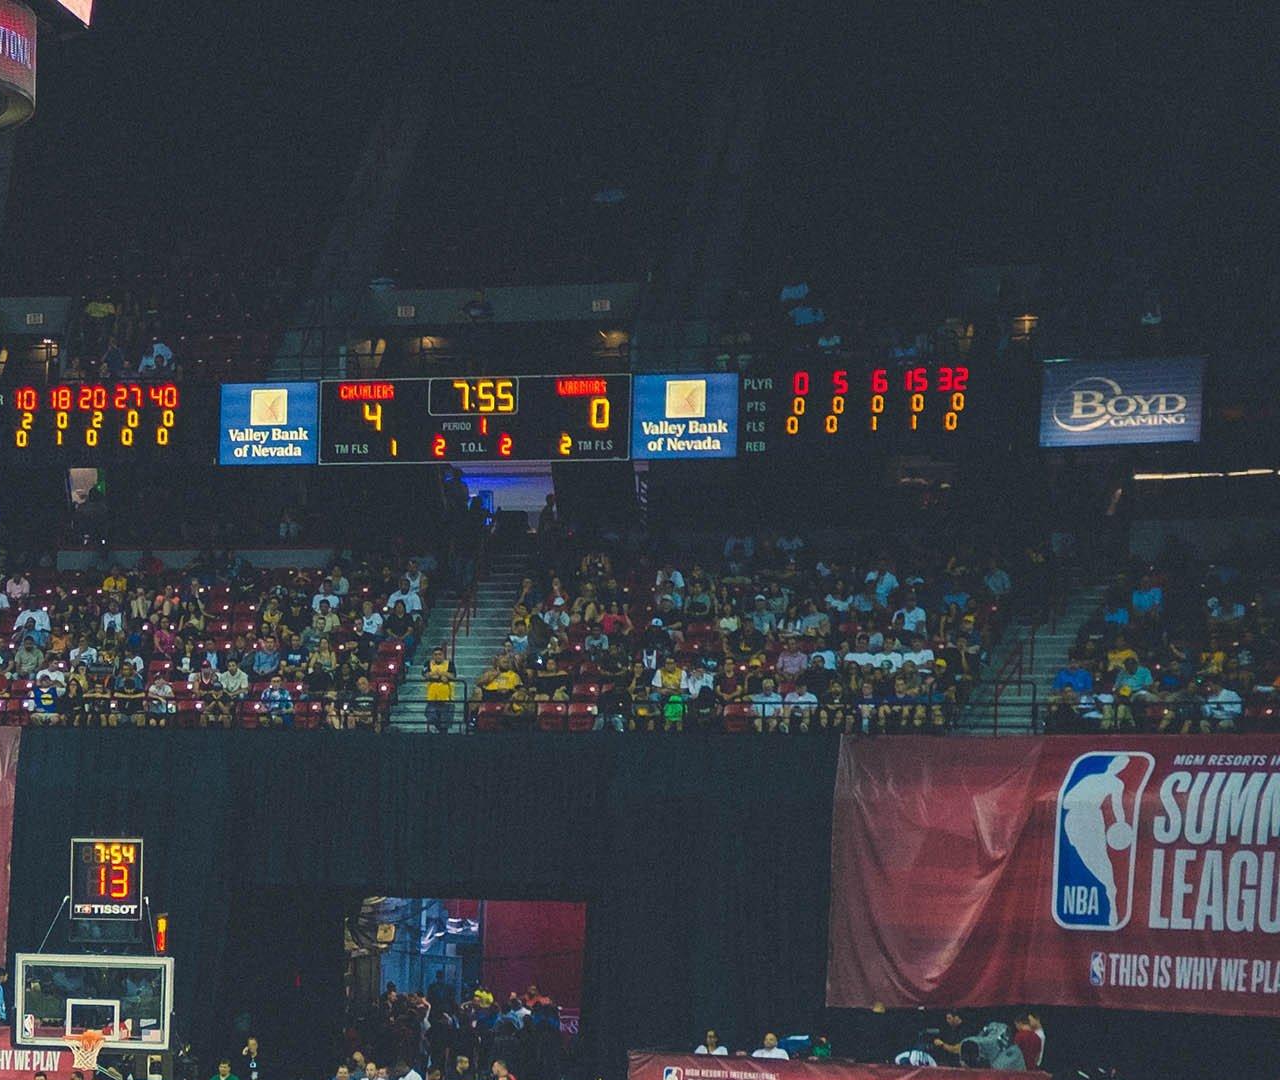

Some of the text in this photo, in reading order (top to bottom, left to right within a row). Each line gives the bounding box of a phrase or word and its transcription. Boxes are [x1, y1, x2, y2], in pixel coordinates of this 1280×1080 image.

[340, 384, 395, 399] CAVALIERS
[744, 367, 969, 395] PLYR 0 5 6 15 32
[15, 388, 37, 411] 10
[51, 388, 72, 410] 18
[79, 387, 107, 409] 20
[115, 386, 142, 409] 27
[151, 386, 178, 409] 40
[453, 381, 514, 411] 7:55
[747, 392, 965, 415] PTS 0 0 0 0 0
[1070, 390, 1187, 419] BOYD
[22, 412, 33, 430] 2
[56, 411, 68, 429] 0
[92, 411, 103, 428] 2
[127, 410, 139, 428] 0
[163, 409, 174, 427] 0
[363, 403, 382, 431] 4
[591, 397, 610, 429] 0
[746, 412, 957, 435] FLS 0 0 0
[1110, 414, 1185, 427] GAMING
[16, 430, 27, 447] 0
[86, 429, 97, 446] 0
[121, 428, 133, 446] 0
[157, 427, 168, 445] 0
[229, 427, 308, 443] Valley Bank
[642, 419, 728, 437] Valley Bank
[234, 444, 302, 457] of Nevada
[335, 438, 398, 456] TM FLS 1
[435, 437, 446, 456] 2
[500, 436, 512, 455] 2
[559, 435, 613, 455] 2 TM FLS
[648, 437, 721, 451] of Nevada
[746, 441, 766, 452] REB
[1174, 755, 1204, 766] MGM
[1208, 754, 1268, 766] RESORTS
[95, 843, 136, 864] 7:54
[99, 865, 128, 898] 13
[92, 904, 138, 914] TISSOT
[1063, 886, 1099, 916] NBA
[1109, 953, 1149, 988] THIS
[1153, 954, 1171, 988] IS
[1175, 956, 1216, 990] WHY
[1221, 957, 1247, 992] WE
[14, 1050, 31, 1071] WE
[33, 1050, 60, 1072] PLAY
